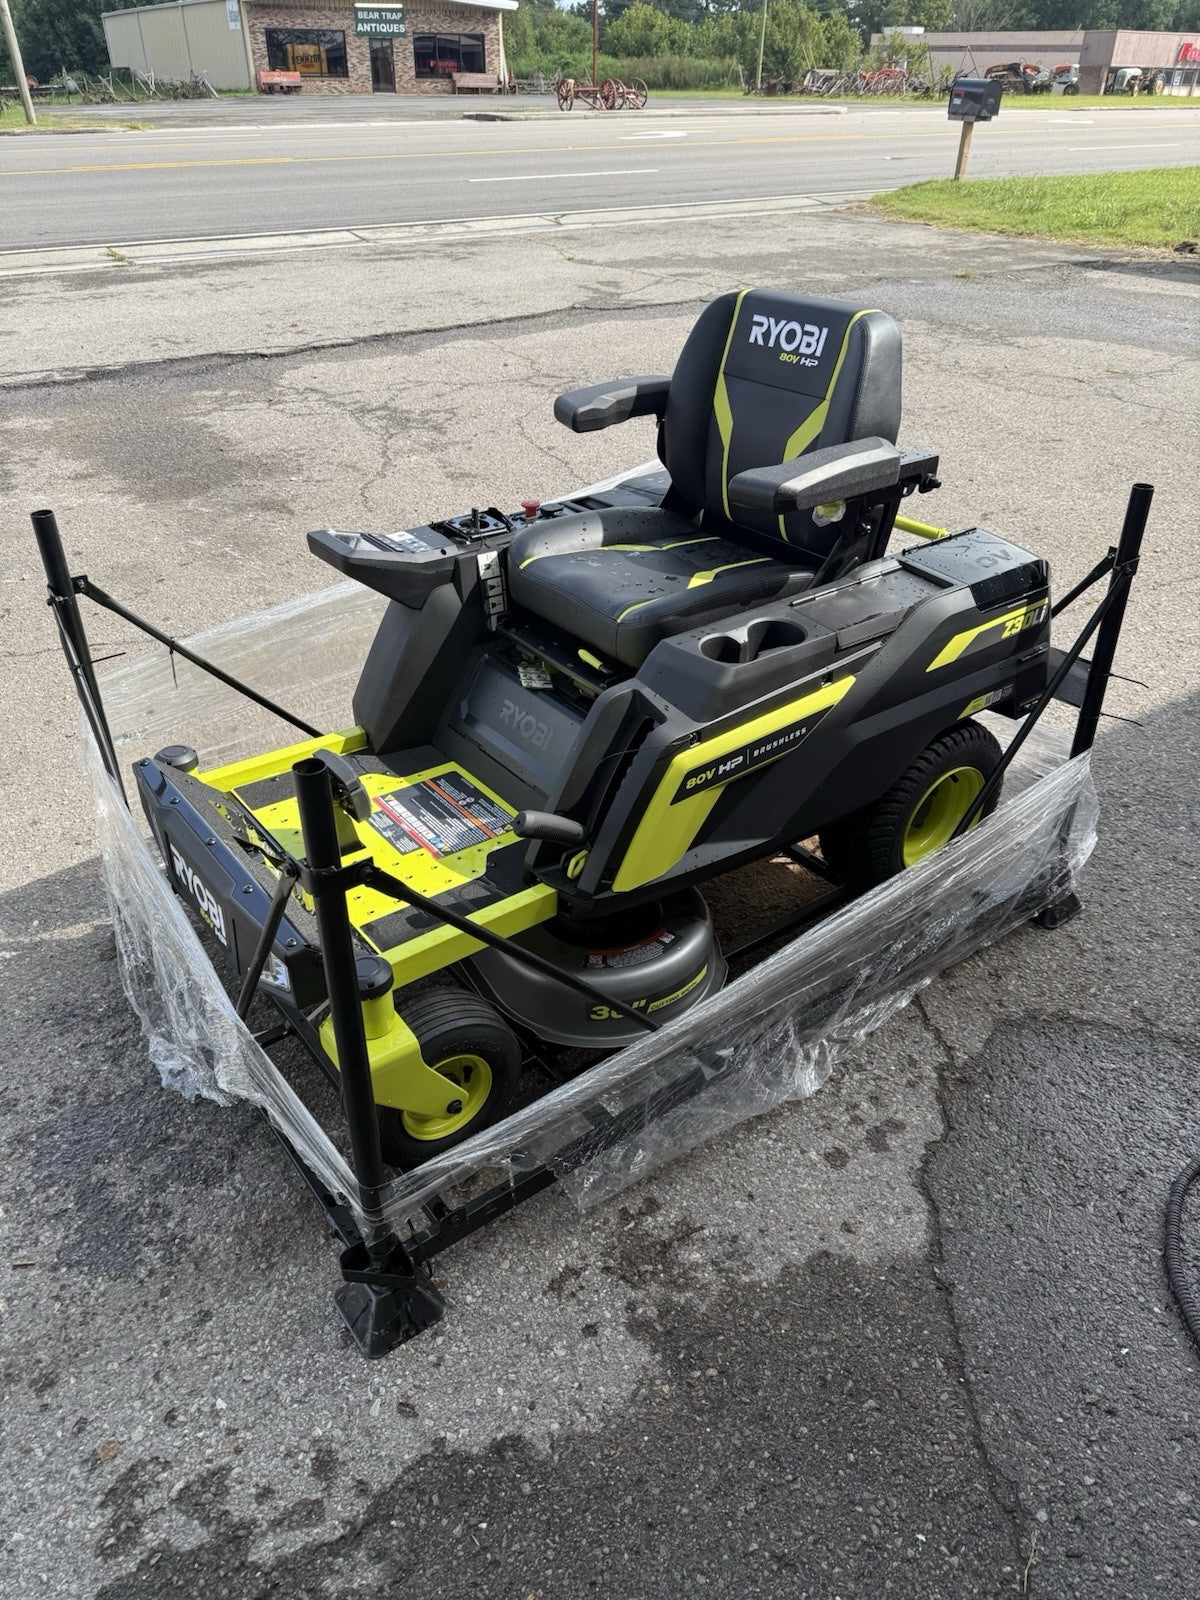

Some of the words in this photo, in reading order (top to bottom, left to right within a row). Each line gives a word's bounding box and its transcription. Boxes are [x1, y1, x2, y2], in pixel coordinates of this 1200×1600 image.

[357, 11, 380, 20] BEAR
[381, 11, 403, 20] TRAP
[357, 22, 406, 33] ANTIQUES
[748, 314, 829, 358] RYOBI
[779, 352, 801, 365] 80V
[799, 357, 819, 368] HP
[497, 699, 553, 751] RYOBI
[685, 767, 717, 790] 80V
[717, 755, 744, 776] HP
[752, 726, 808, 758] BRUSHLESS
[169, 842, 227, 939] RYOBI
